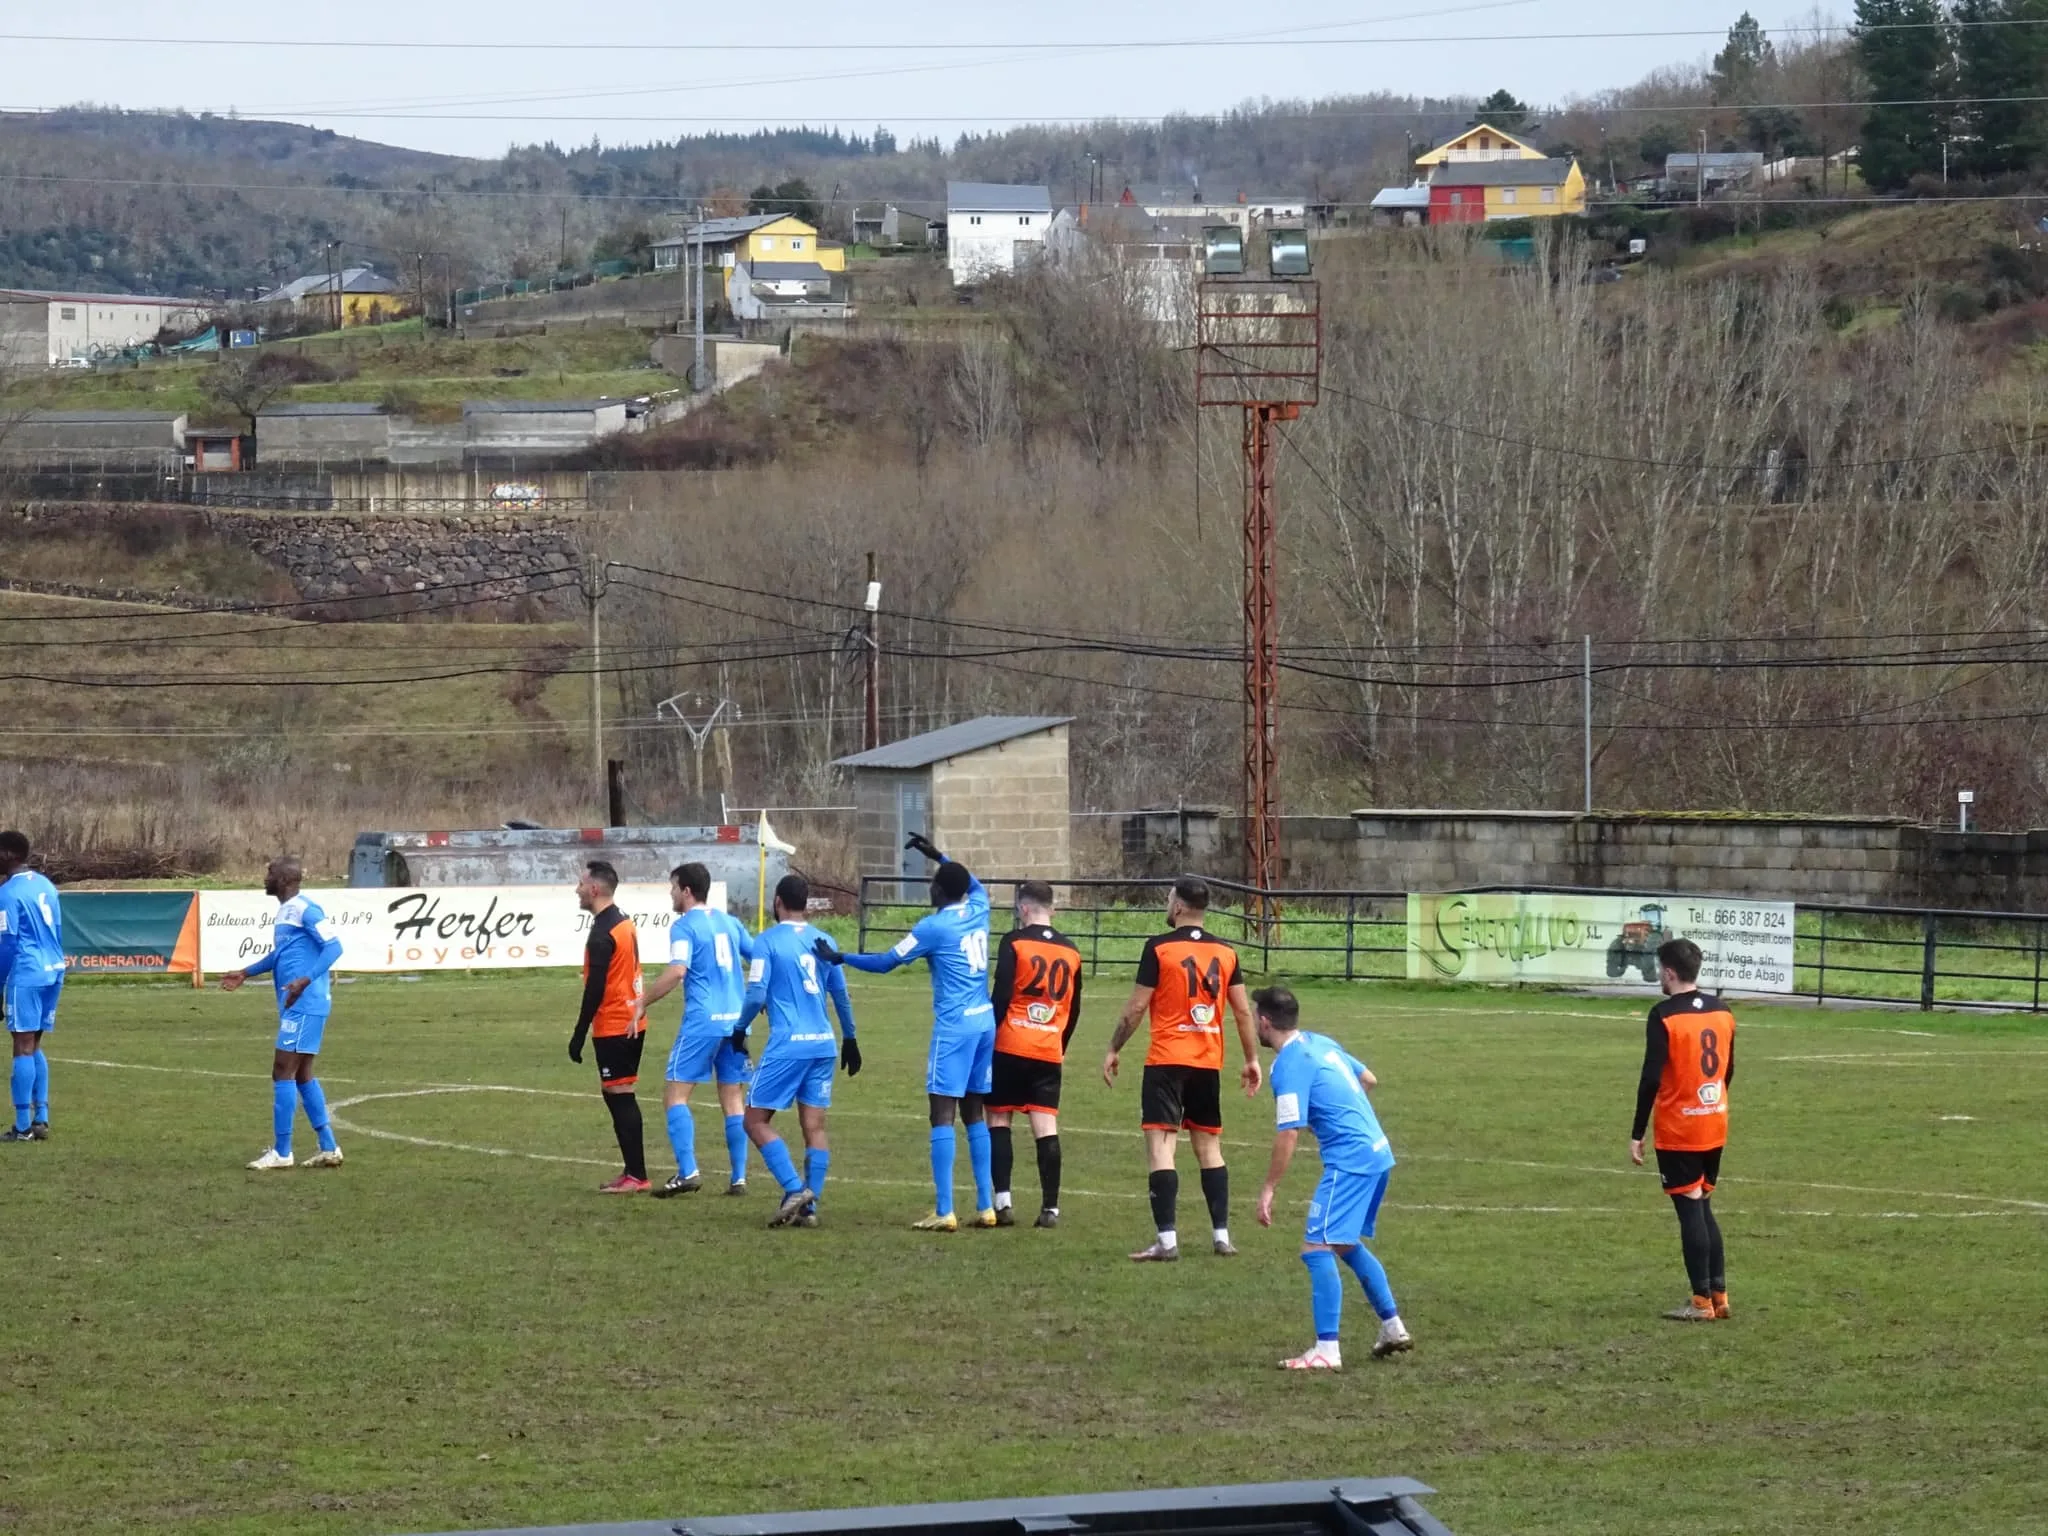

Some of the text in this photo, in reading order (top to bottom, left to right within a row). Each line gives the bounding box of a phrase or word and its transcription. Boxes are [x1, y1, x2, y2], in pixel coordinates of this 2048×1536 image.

[207, 912, 256, 927] Bulevar
[387, 893, 536, 955] Herfer
[652, 912, 670, 928] 40
[1688, 907, 1786, 928] Tel.: 666 387 824
[1586, 925, 1603, 940] S.L.
[80, 954, 164, 969] GENERATION
[386, 944, 550, 965] joyeros
[713, 932, 733, 973] 4
[959, 930, 988, 975] 10
[1701, 949, 1722, 963] Ctra.
[1726, 951, 1758, 967] Vega,
[800, 953, 820, 995] 3
[1022, 955, 1071, 1002] 20
[1180, 955, 1221, 1000] 14
[1738, 969, 1752, 980] de
[1754, 969, 1785, 985] Abajo
[1700, 1028, 1720, 1079] 8
